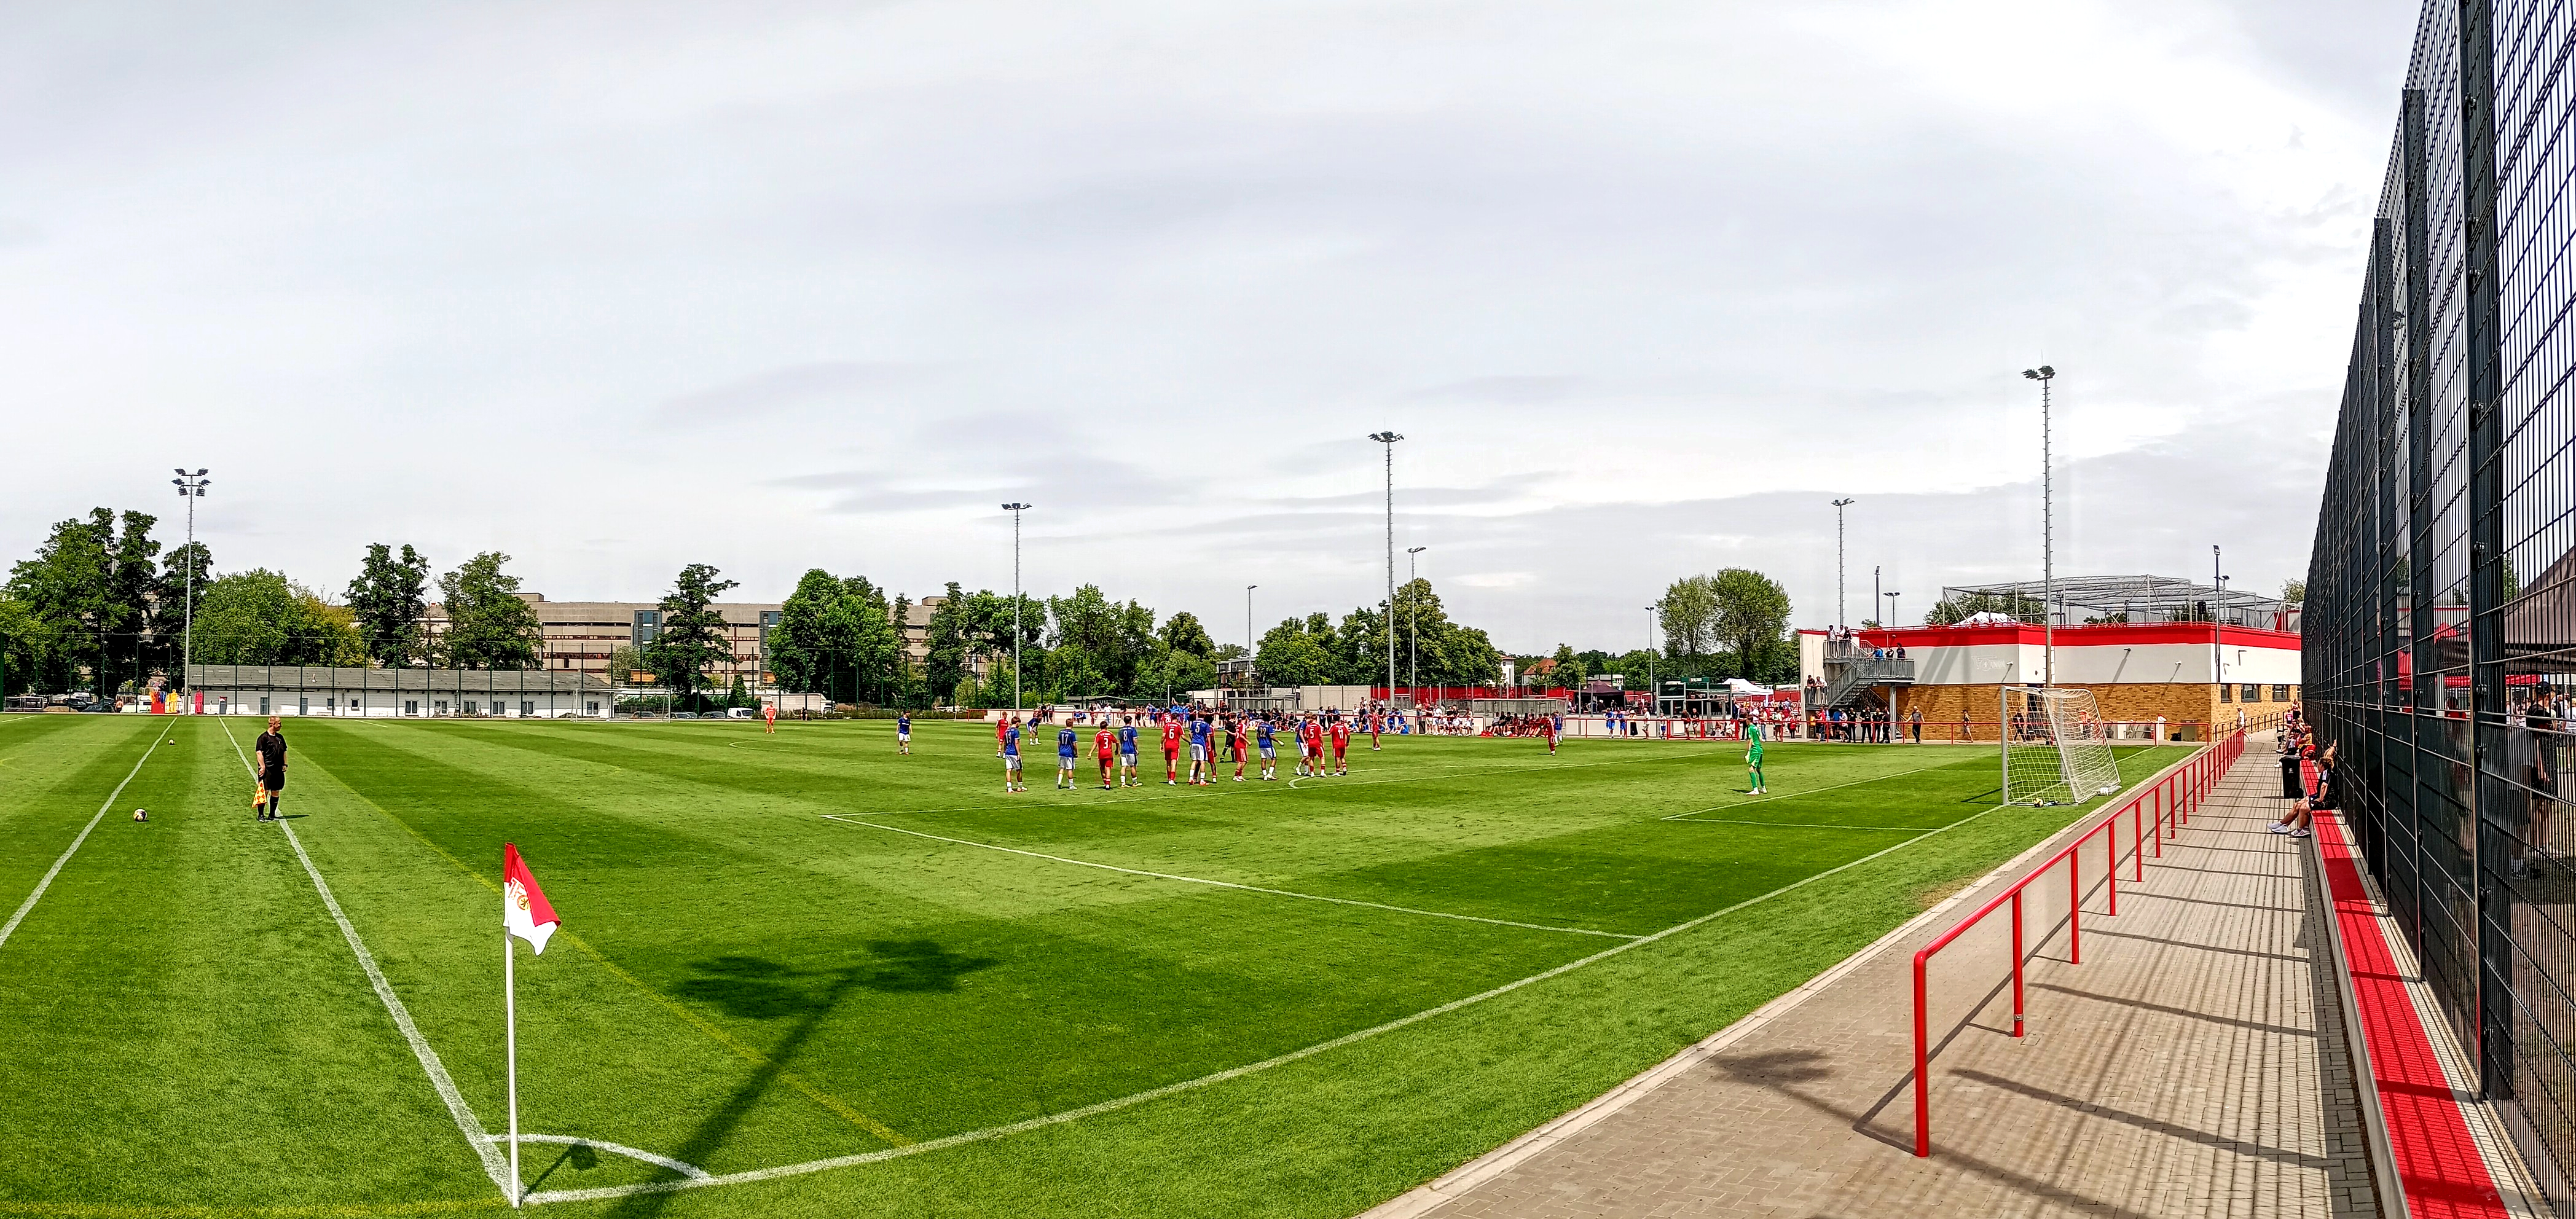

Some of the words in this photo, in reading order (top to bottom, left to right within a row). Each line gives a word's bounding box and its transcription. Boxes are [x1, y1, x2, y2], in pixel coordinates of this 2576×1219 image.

[1169, 728, 1174, 739] 6
[1195, 723, 1201, 733] 5
[1259, 727, 1266, 737] 22
[1310, 728, 1314, 739] 5
[1061, 734, 1069, 745] 17
[1123, 730, 1128, 741] 8
[1103, 737, 1109, 749] 3
